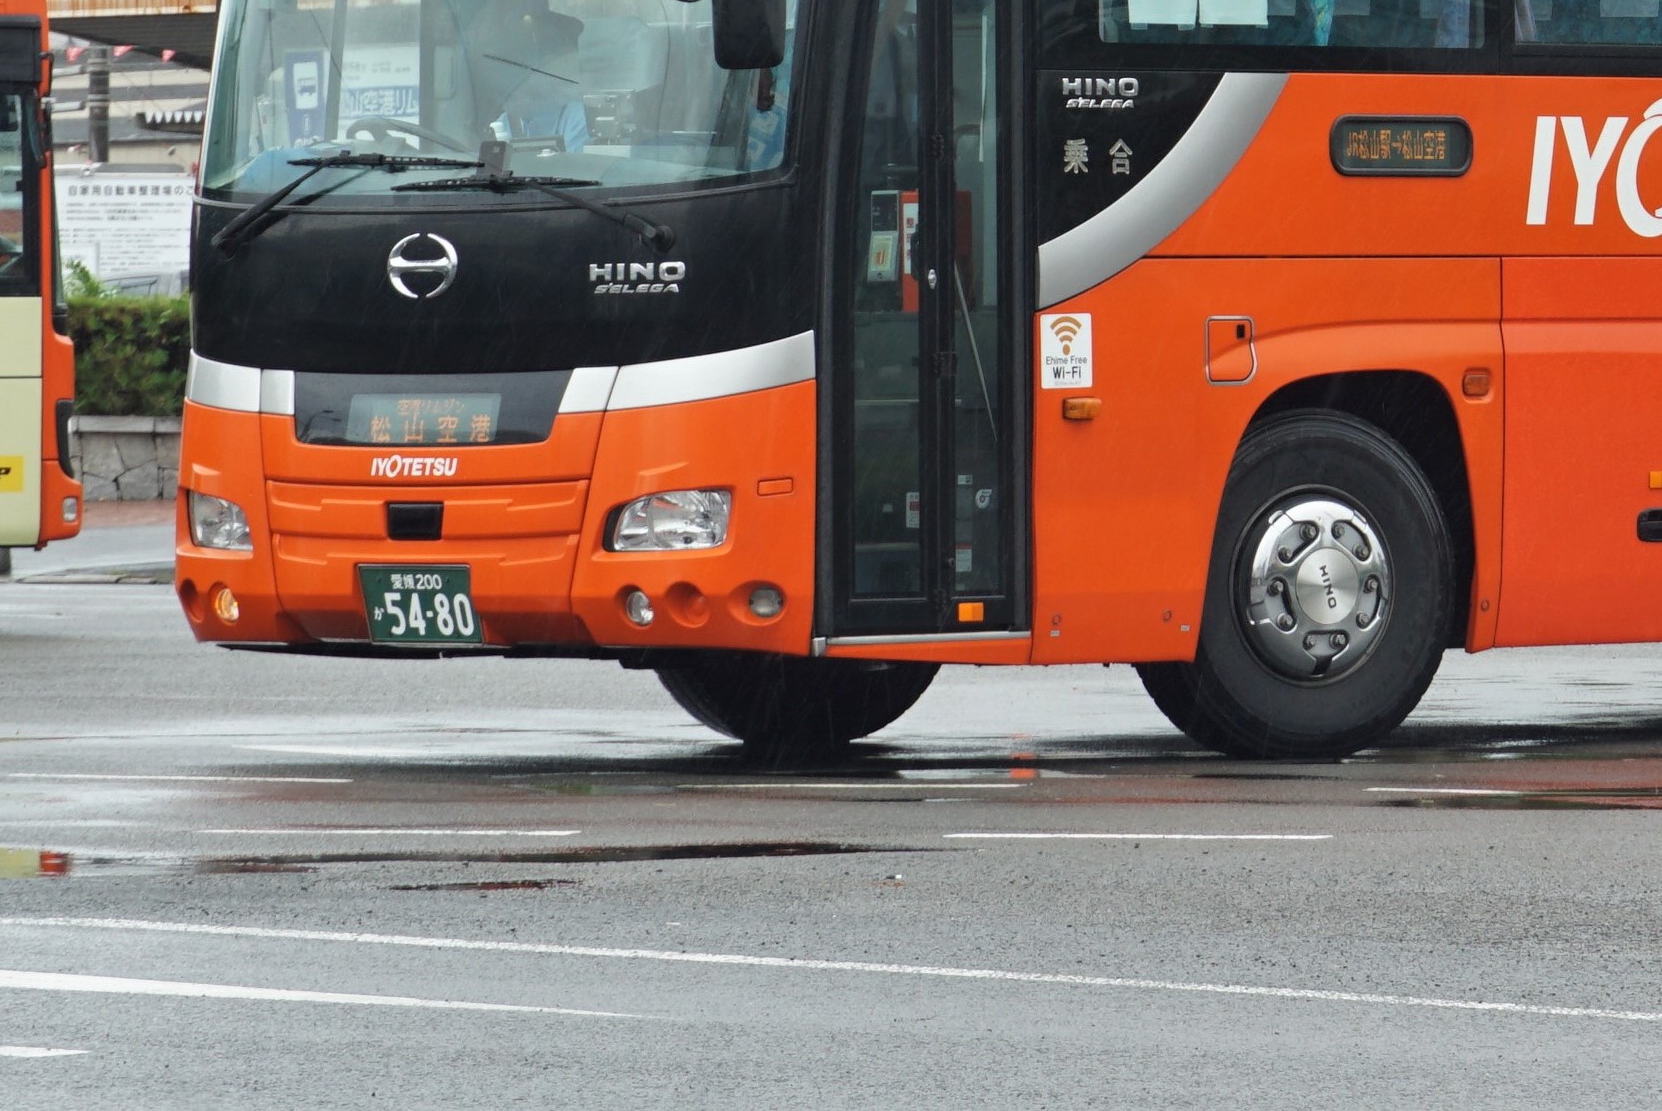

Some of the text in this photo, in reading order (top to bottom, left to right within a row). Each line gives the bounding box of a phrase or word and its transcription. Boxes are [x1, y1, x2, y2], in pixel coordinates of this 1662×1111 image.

[1062, 77, 1139, 96] HINO
[589, 261, 686, 281] HINO
[1045, 355, 1088, 365] Ehime Free
[1052, 366, 1082, 379] Wi-Fi
[371, 414, 491, 443] 松山空港
[370, 454, 459, 479] IYOTETSU
[1319, 565, 1337, 609] HINO
[383, 592, 475, 637] 54-80
